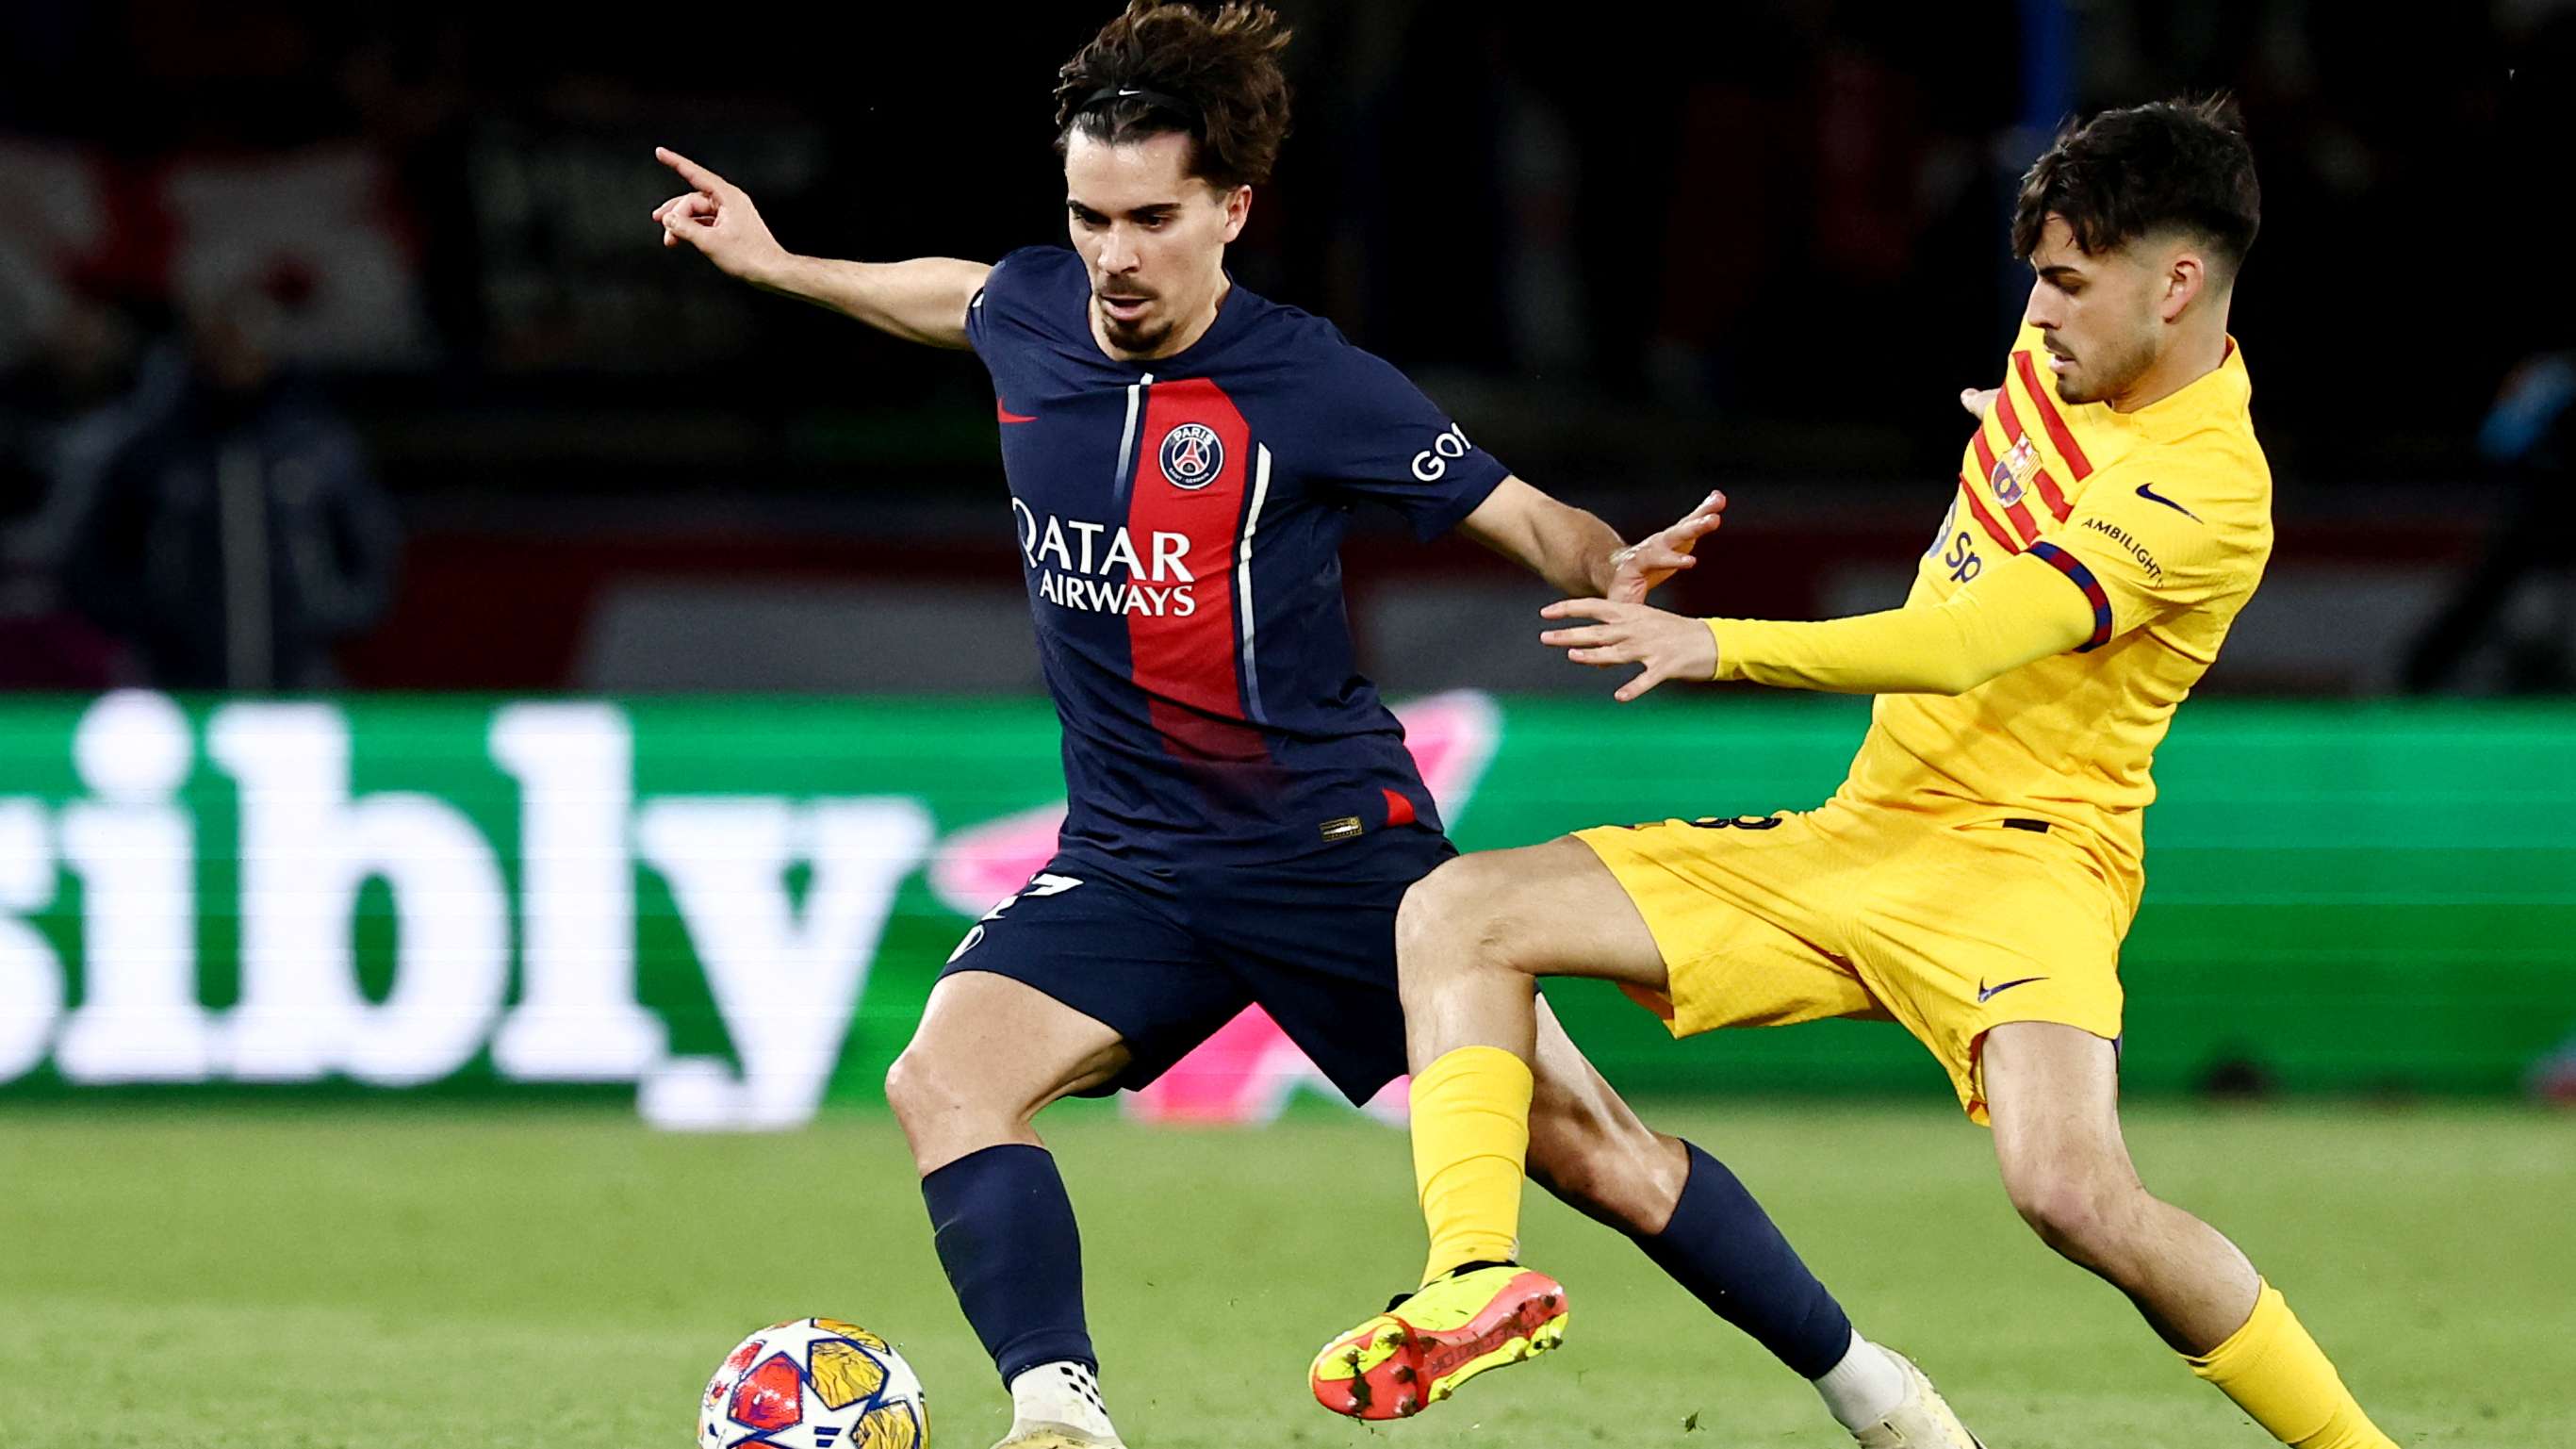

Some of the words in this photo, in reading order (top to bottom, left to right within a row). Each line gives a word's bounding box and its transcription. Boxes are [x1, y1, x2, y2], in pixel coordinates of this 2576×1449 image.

[1173, 427, 1214, 446] PARIS
[1011, 497, 1195, 583] QATAR
[1945, 531, 1981, 583] Sp
[2080, 518, 2161, 579] AMBILIGHT
[1039, 568, 1195, 617] AIRWAYS
